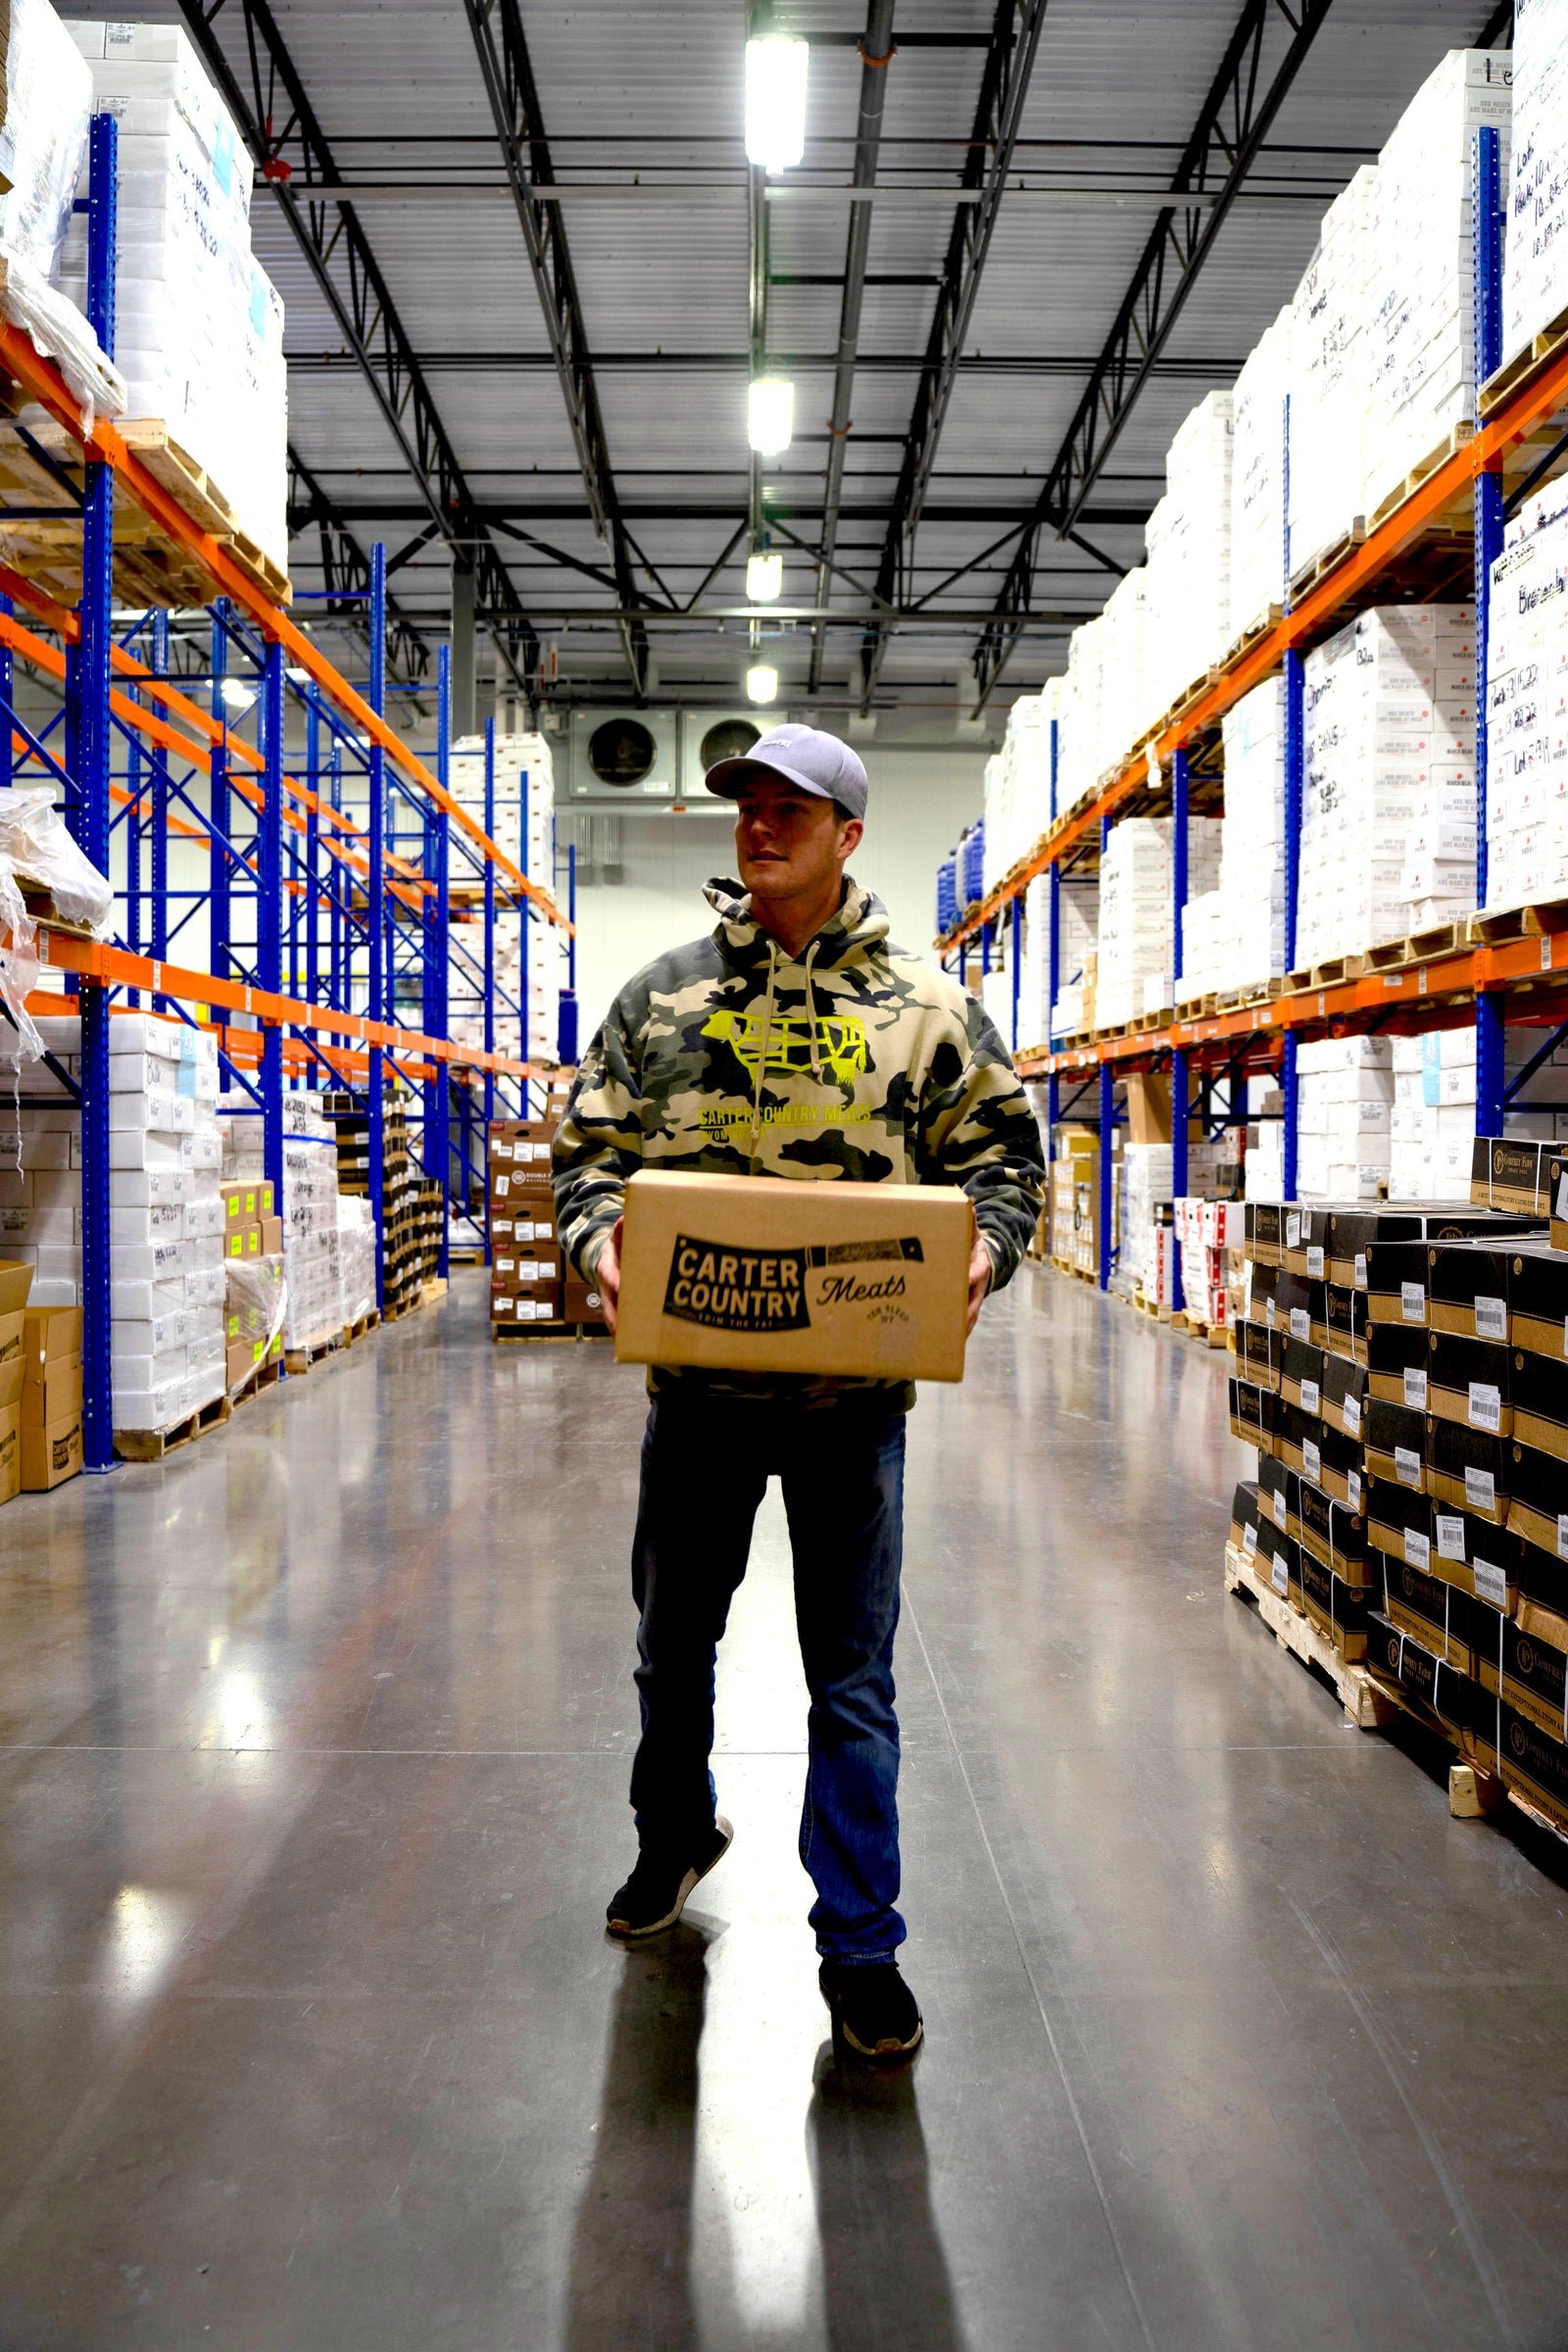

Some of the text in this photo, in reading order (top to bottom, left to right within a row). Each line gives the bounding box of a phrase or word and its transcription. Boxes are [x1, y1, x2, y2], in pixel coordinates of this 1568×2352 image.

[699, 1103, 871, 1126] CARTER COUNTRY MEATS
[677, 1248, 800, 1289] CARTER
[673, 1279, 801, 1318] COUNTRY
[815, 1274, 906, 1305] Meats
